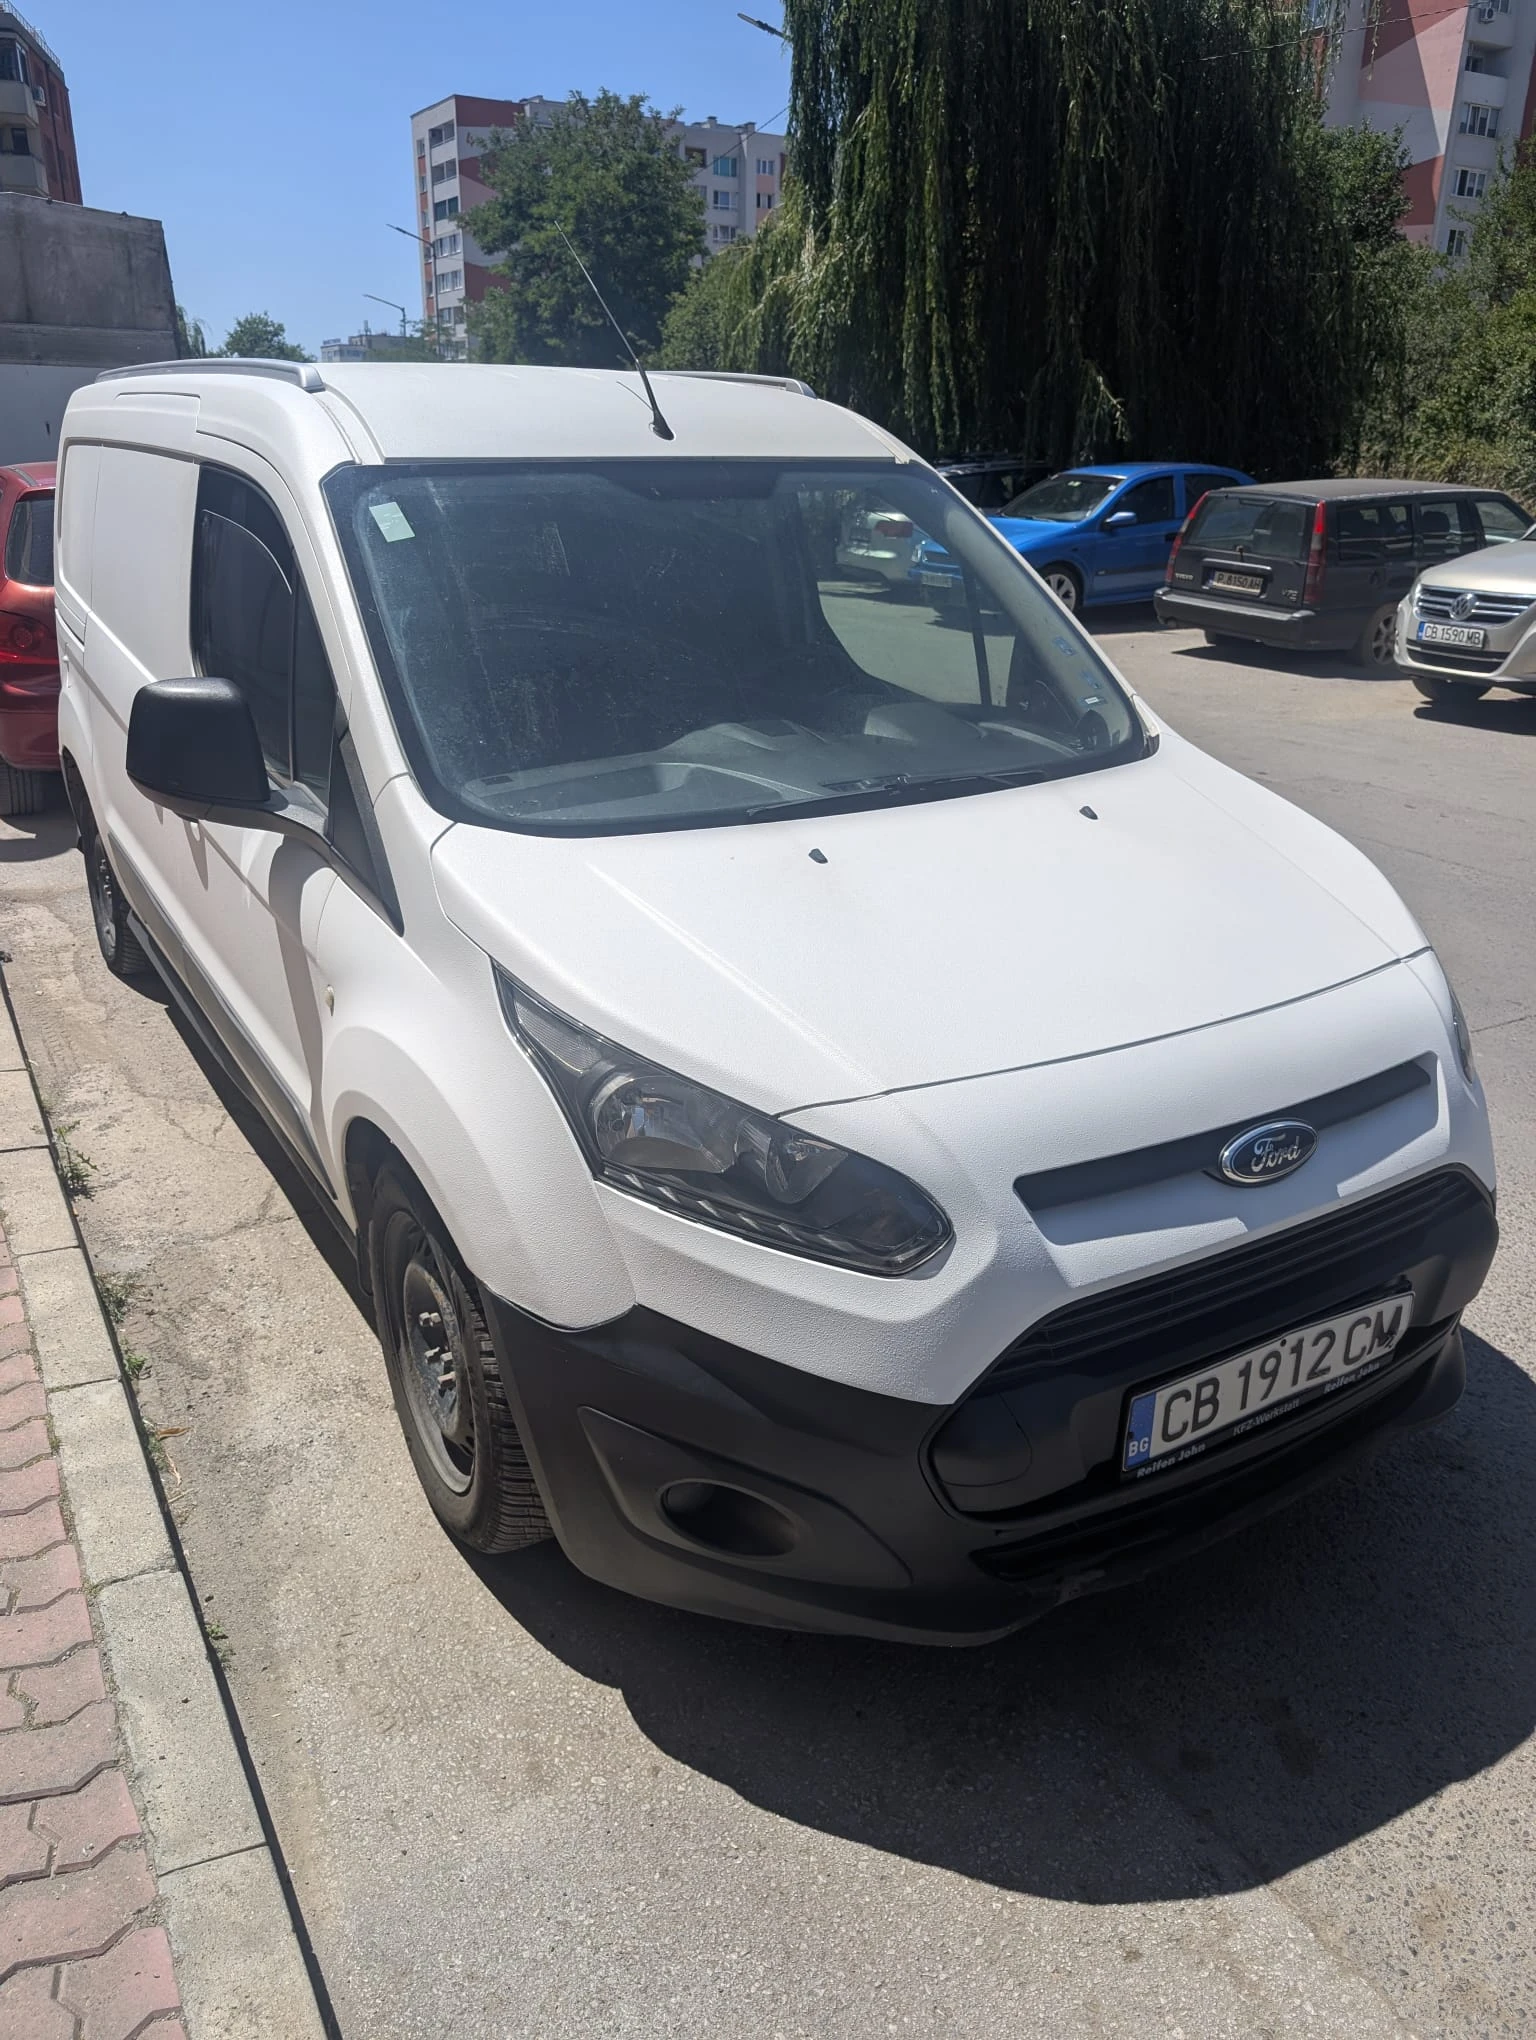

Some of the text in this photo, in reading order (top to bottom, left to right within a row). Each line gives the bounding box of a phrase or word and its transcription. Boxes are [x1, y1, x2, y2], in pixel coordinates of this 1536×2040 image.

[1424, 625, 1438, 639] CB
[1441, 628, 1465, 643] 1590
[1251, 1133, 1301, 1172] Ford
[1162, 1305, 1403, 1443] CB 1912 CM
[1233, 1398, 1300, 1436] KFZ-Werkstatt
[1128, 1437, 1149, 1457] BG
[1137, 1443, 1206, 1478] Reifen John
